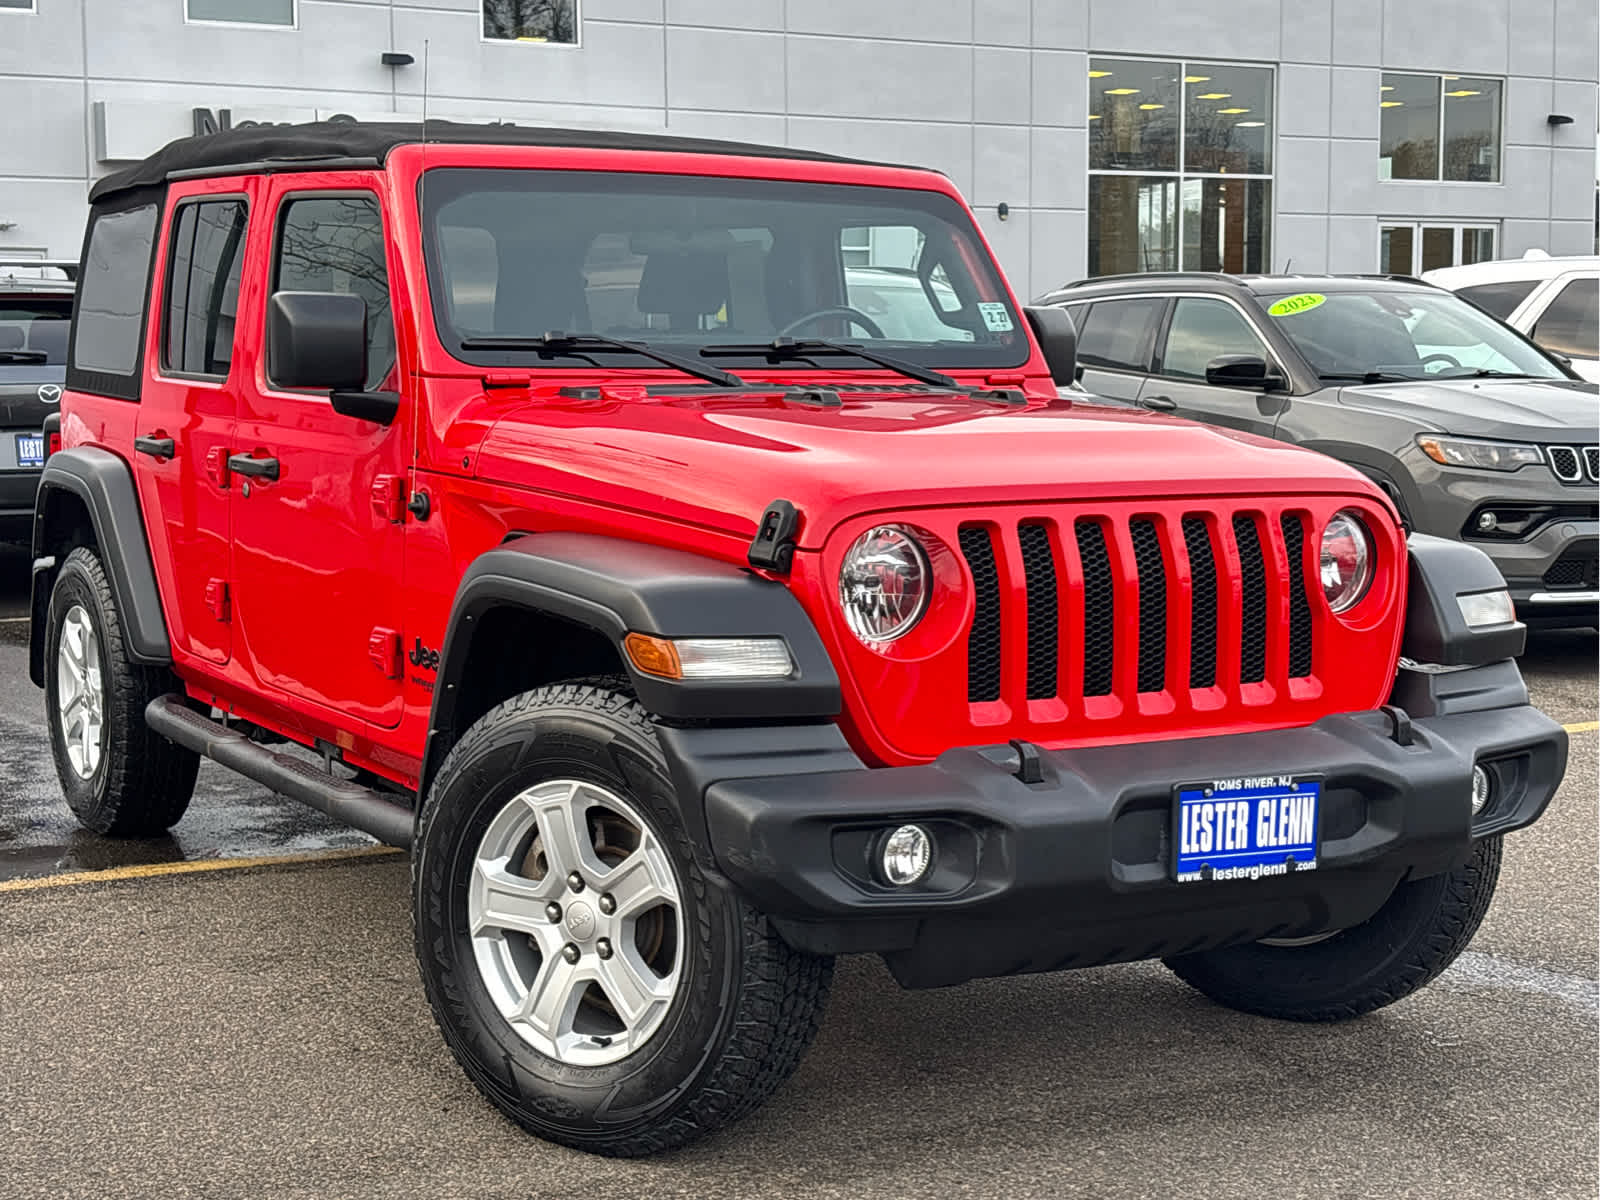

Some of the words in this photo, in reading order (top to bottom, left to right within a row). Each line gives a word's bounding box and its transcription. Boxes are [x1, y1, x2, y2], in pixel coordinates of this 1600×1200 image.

[1278, 295, 1317, 313] 2023
[19, 440, 44, 459] LEST
[409, 636, 441, 673] Jee
[1213, 779, 1242, 791] TOMS
[1278, 775, 1292, 787] NJ
[1180, 802, 1249, 854] LESTER
[1256, 797, 1315, 847] GLENN
[1212, 863, 1287, 880] lesterglenn
